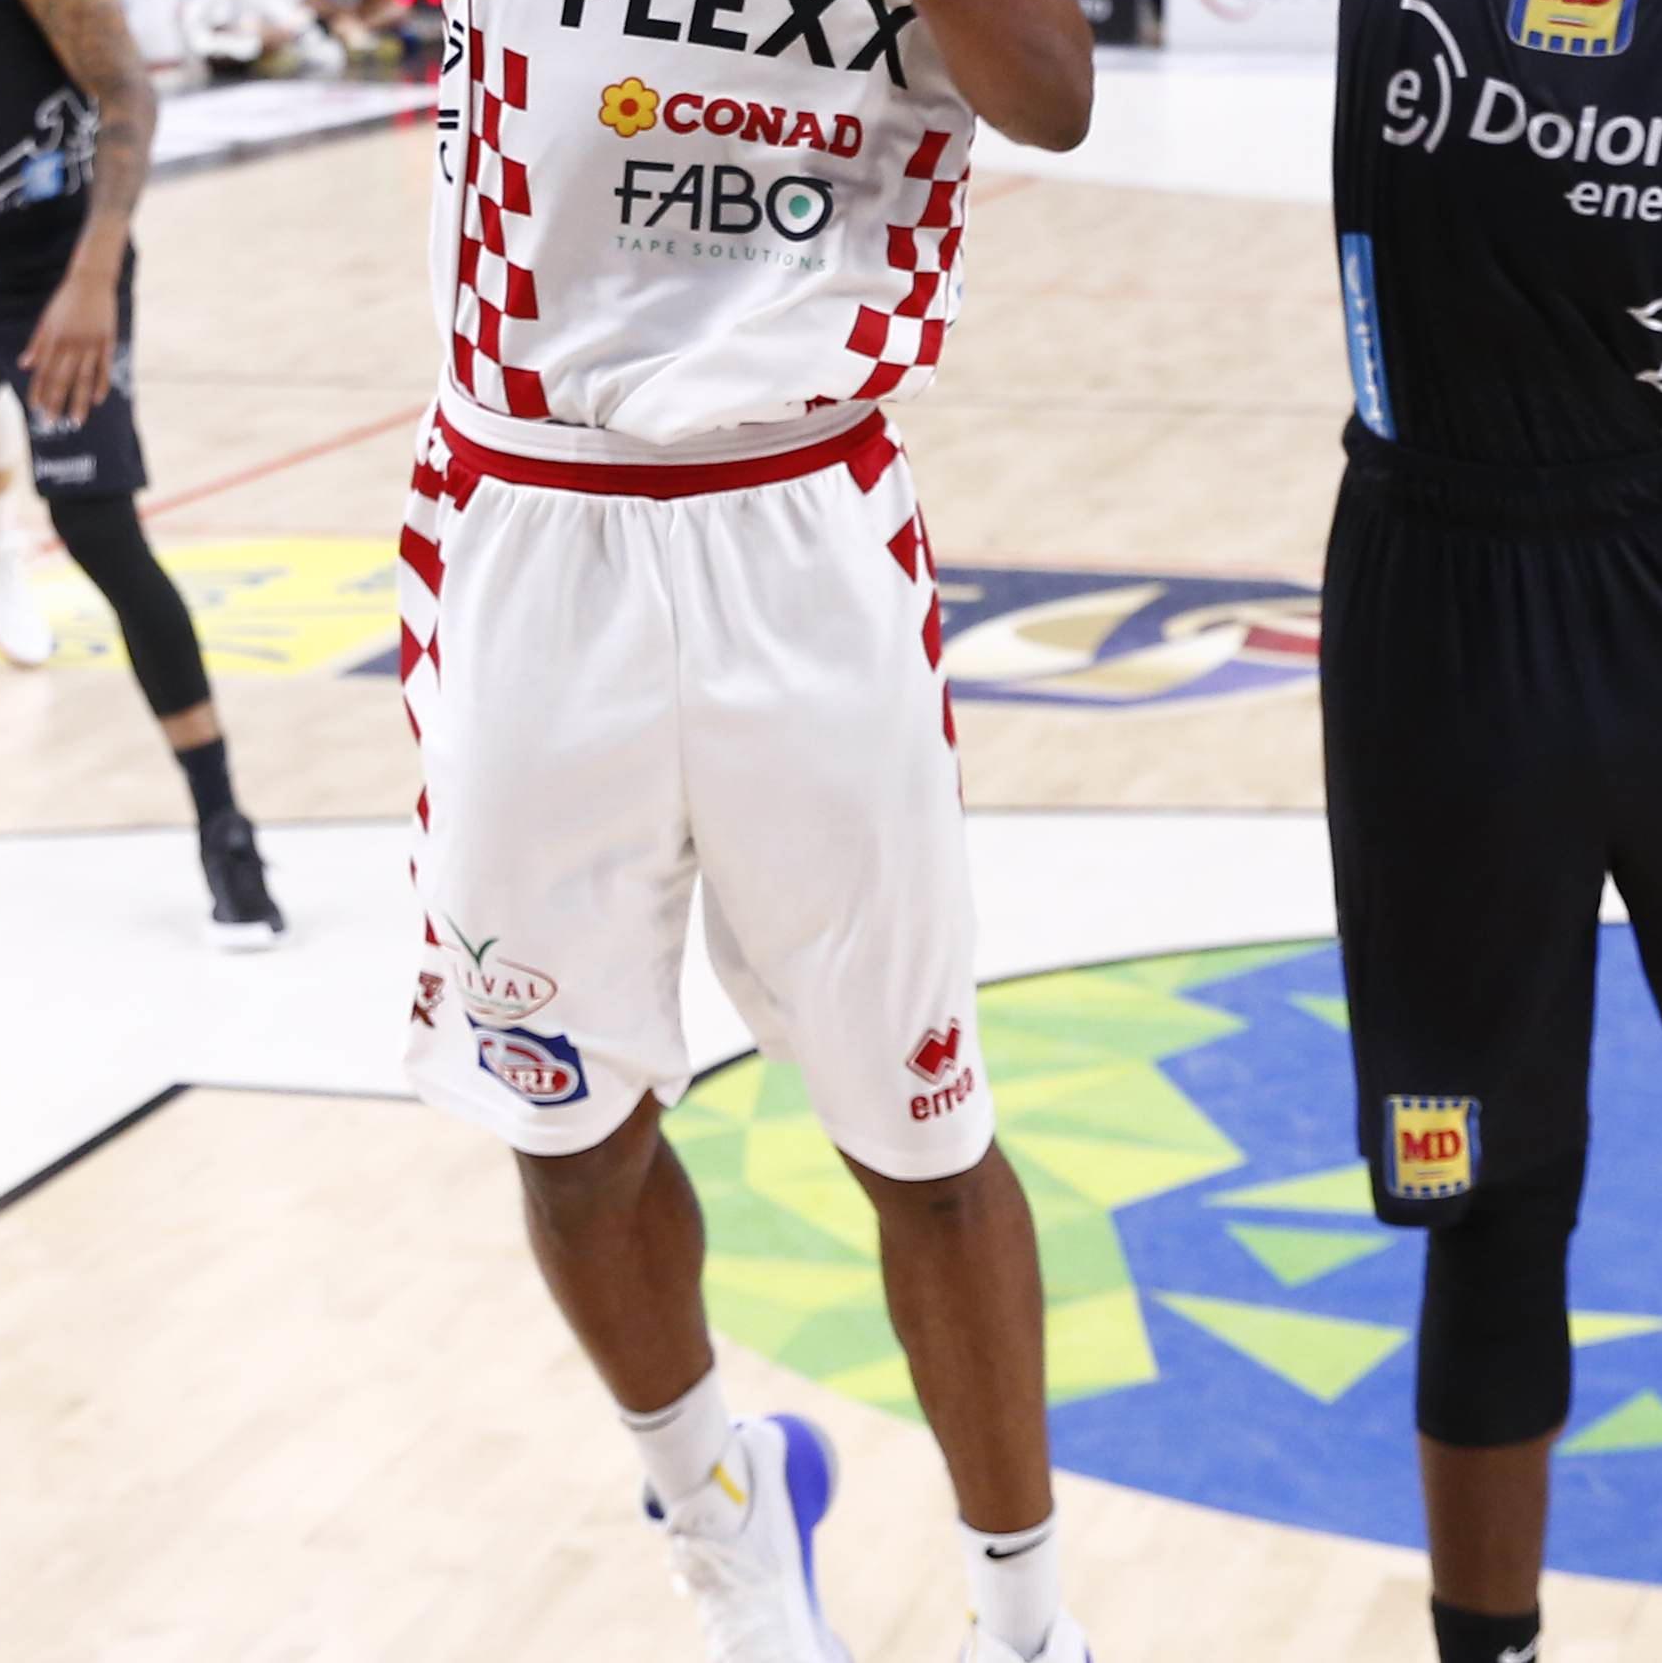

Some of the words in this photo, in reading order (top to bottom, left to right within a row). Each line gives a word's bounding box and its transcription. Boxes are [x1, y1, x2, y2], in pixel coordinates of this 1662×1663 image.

[663, 92, 863, 159] CONAD
[613, 159, 834, 243] FABO
[616, 236, 675, 255] TAPE
[693, 243, 828, 272] SOLUTIONS
[1400, 1130, 1461, 1164] MD
